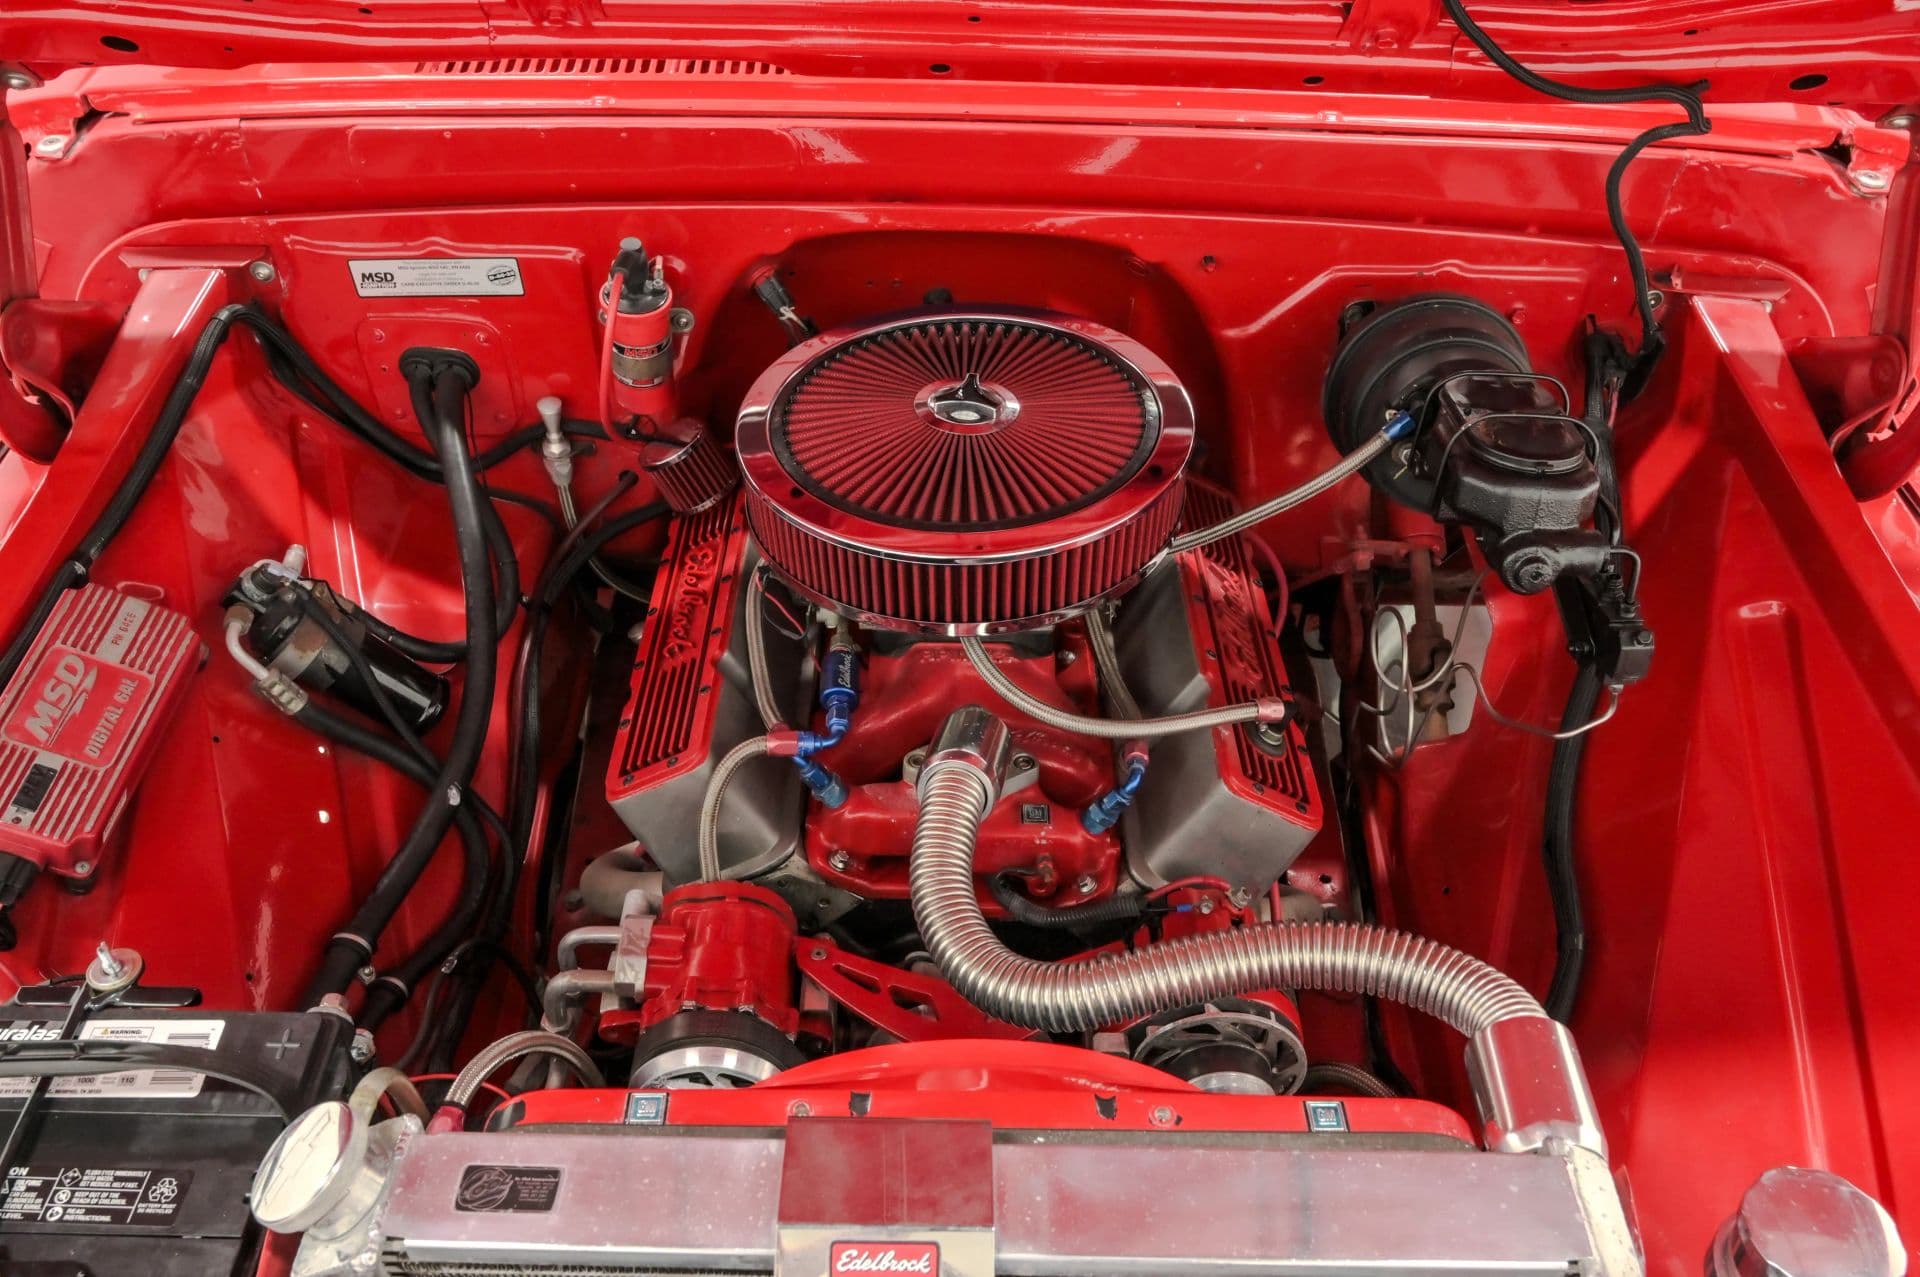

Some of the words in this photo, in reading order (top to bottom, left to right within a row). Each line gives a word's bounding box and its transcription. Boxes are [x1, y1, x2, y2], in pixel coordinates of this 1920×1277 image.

[361, 272, 395, 283] MSD
[25, 654, 85, 743] MSD
[85, 703, 123, 759] DIGITAL
[9, 1166, 30, 1176] ON
[836, 1248, 931, 1273] Edelbrock
